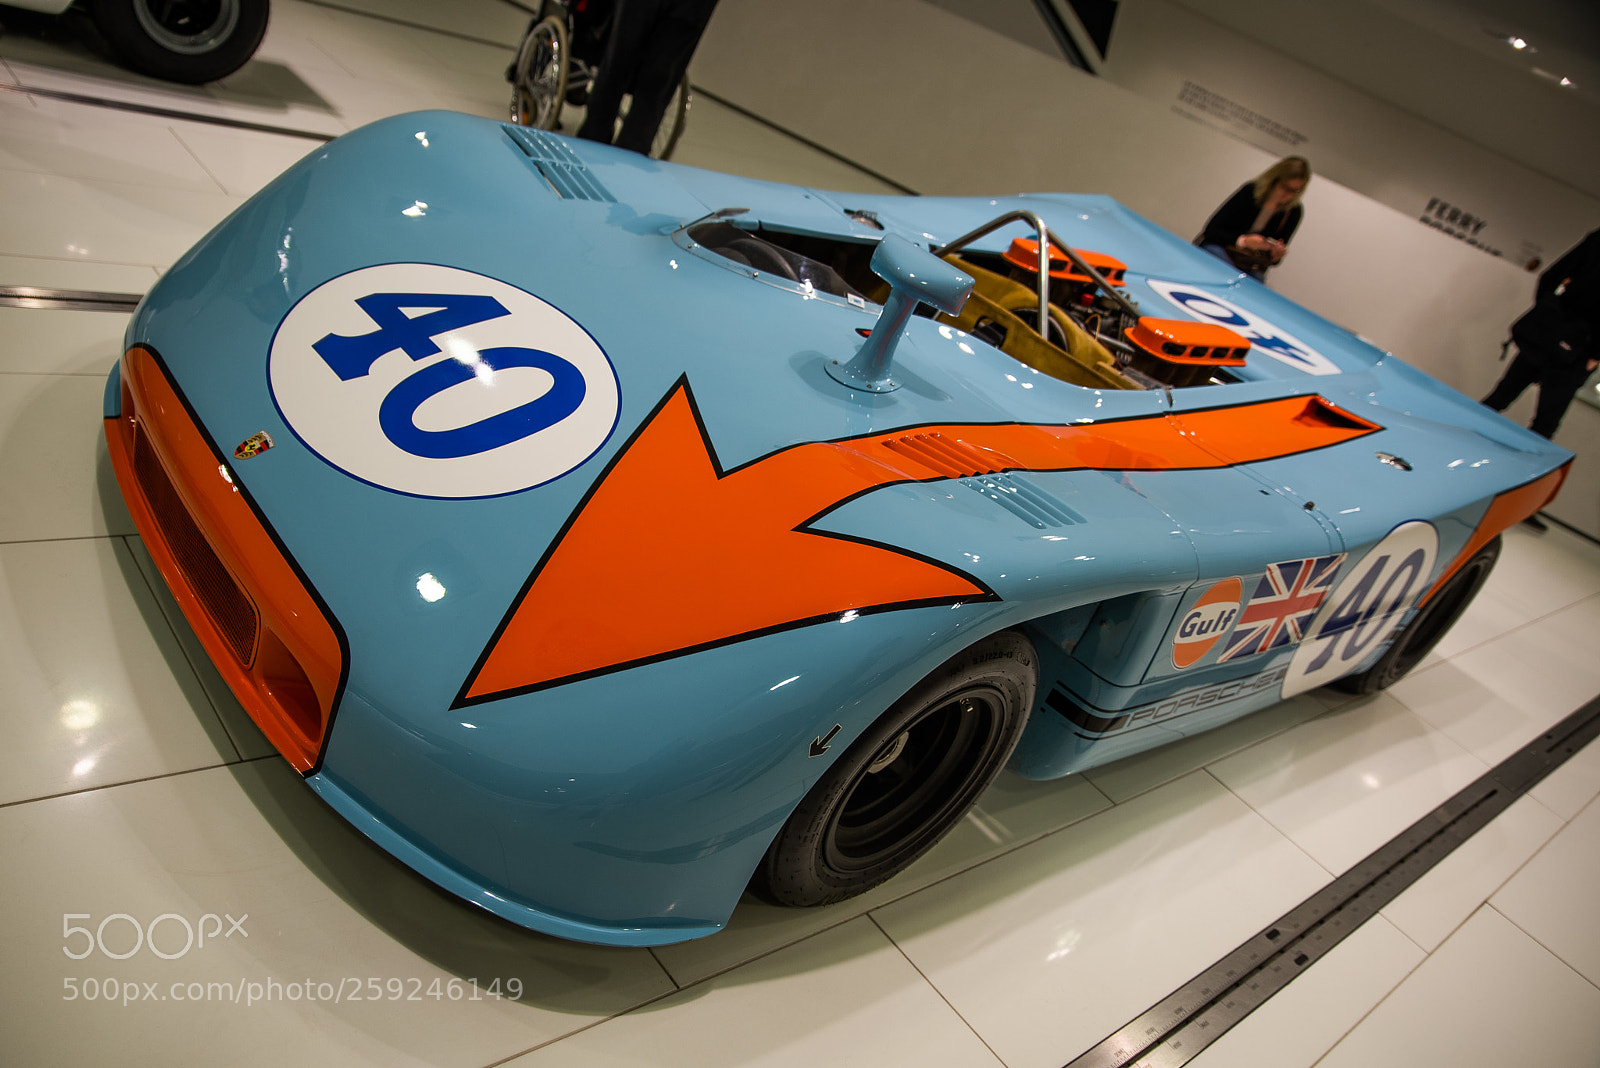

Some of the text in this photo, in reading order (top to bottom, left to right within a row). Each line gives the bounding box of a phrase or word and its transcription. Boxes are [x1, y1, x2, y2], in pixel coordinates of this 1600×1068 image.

[1425, 197, 1488, 236] FERRY
[311, 293, 587, 459] 40
[1179, 607, 1237, 639] Gulf
[1303, 548, 1426, 675] 40
[1126, 671, 1277, 728] PORSCHE
